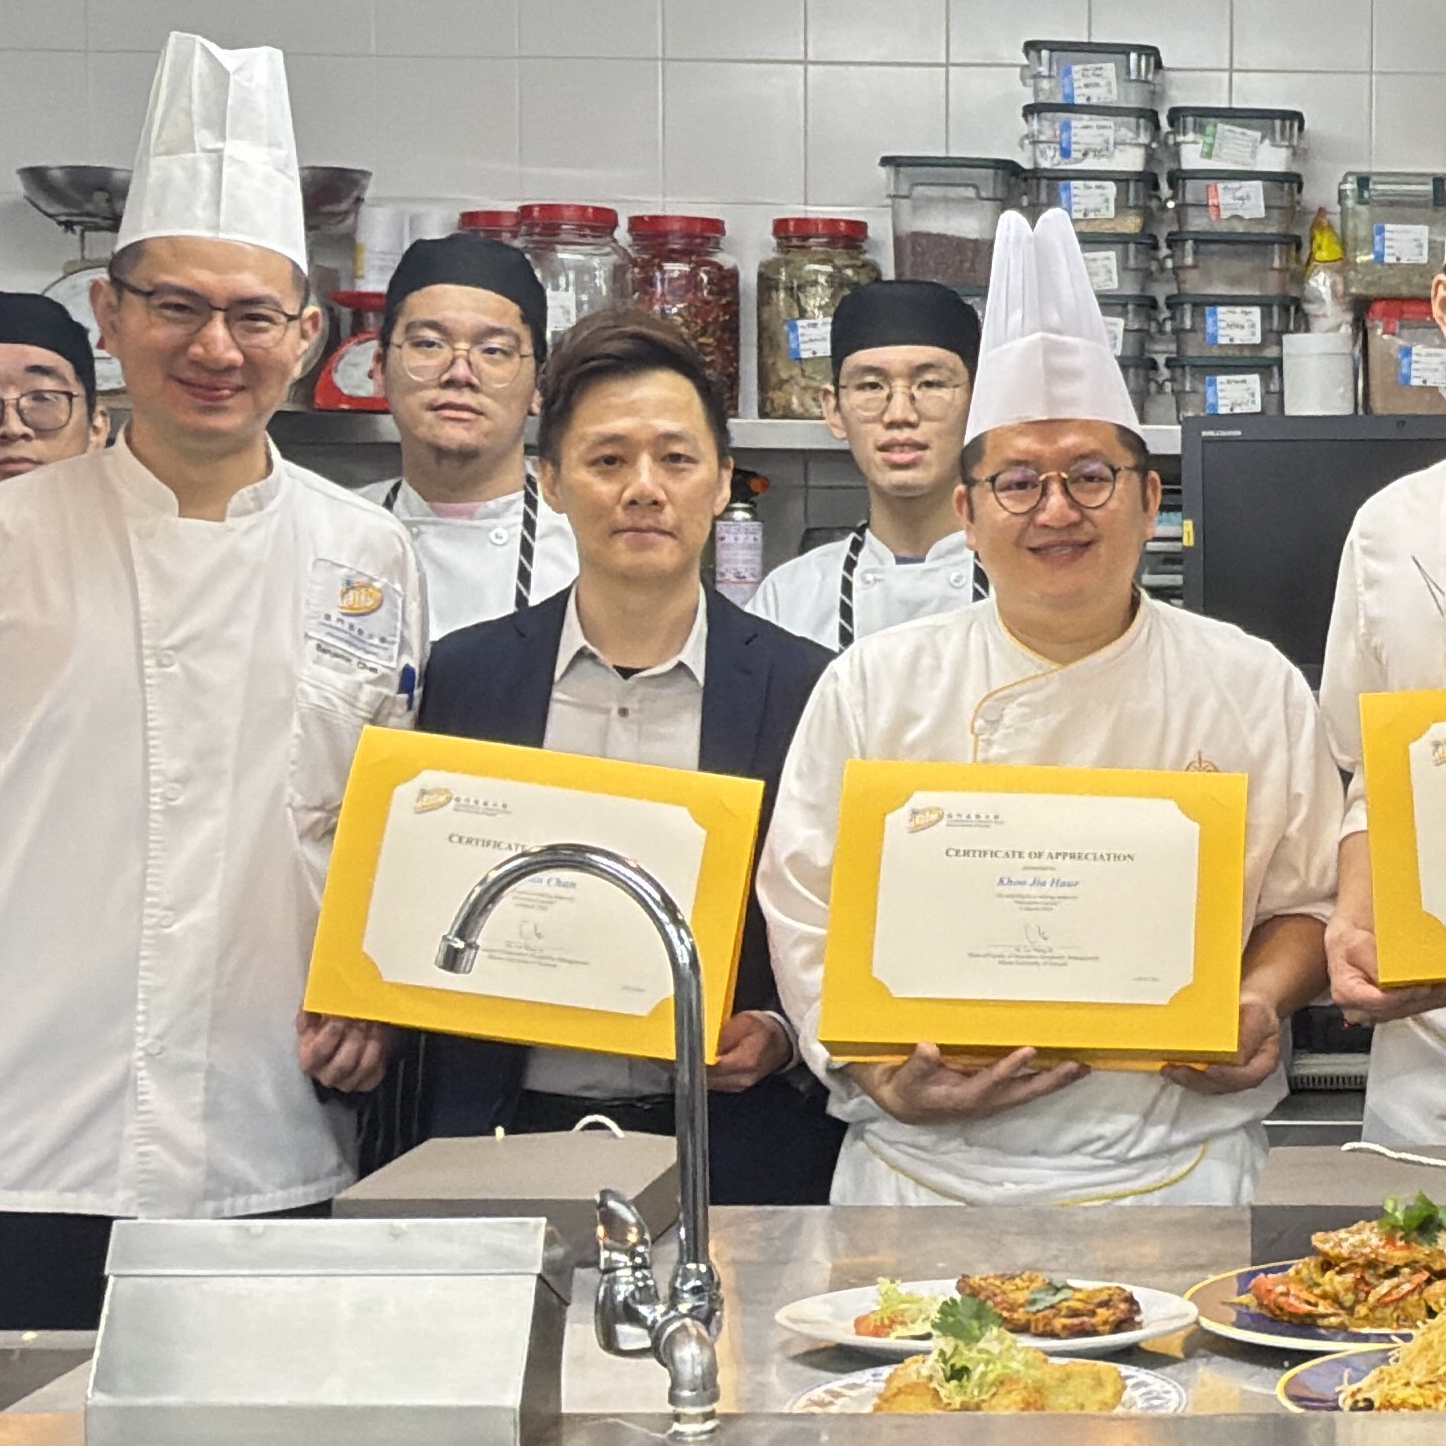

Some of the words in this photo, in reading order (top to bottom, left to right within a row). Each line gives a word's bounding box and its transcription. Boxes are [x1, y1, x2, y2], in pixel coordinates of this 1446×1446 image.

[945, 847, 1025, 859] CERTIFICATE
[1028, 850, 1043, 860] OF
[1046, 851, 1135, 862] APPRECIATION
